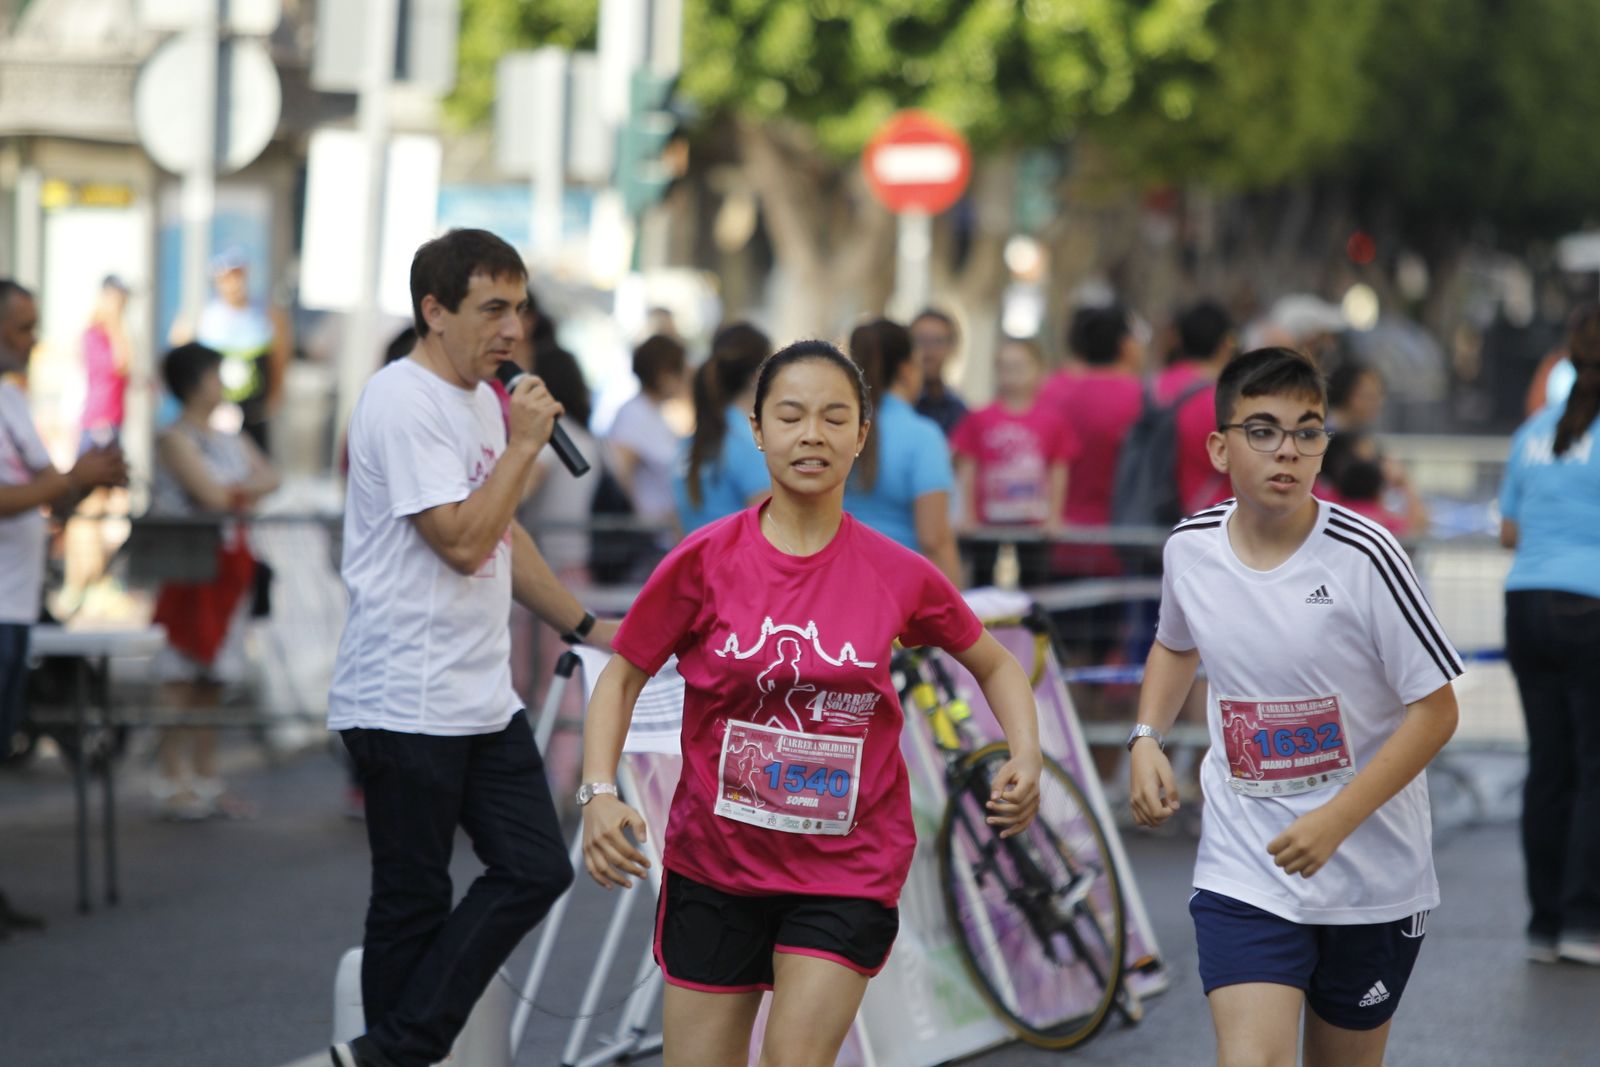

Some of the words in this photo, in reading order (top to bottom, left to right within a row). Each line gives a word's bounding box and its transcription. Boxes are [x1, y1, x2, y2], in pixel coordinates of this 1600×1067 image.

[805, 690, 827, 722] 4
[783, 738, 817, 751] CARRERA
[817, 742, 855, 754] SOLIDARIA
[1253, 722, 1343, 757] 1632
[1260, 760, 1292, 770] JUANJO
[764, 761, 850, 798] 1540
[785, 795, 819, 808] SOPHIA
[1359, 992, 1390, 1007] adidas
